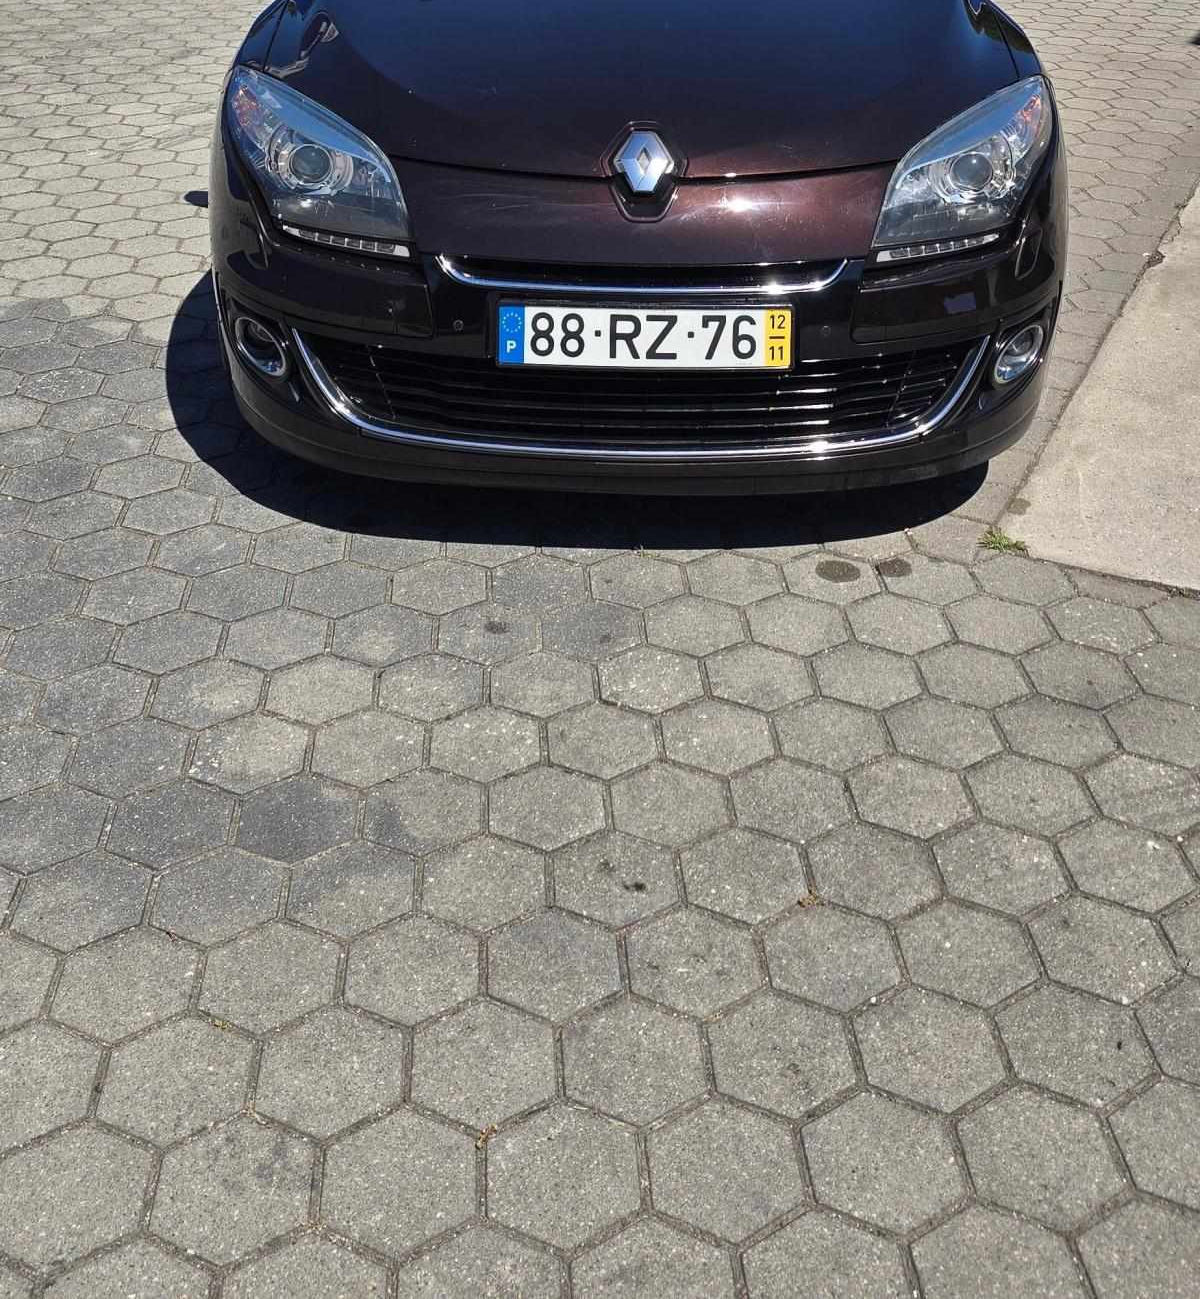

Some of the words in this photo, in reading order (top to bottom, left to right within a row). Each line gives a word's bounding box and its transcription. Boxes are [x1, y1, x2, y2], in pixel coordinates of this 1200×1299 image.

[769, 314, 786, 330] 12
[506, 340, 517, 354] P
[769, 345, 785, 362] 11
